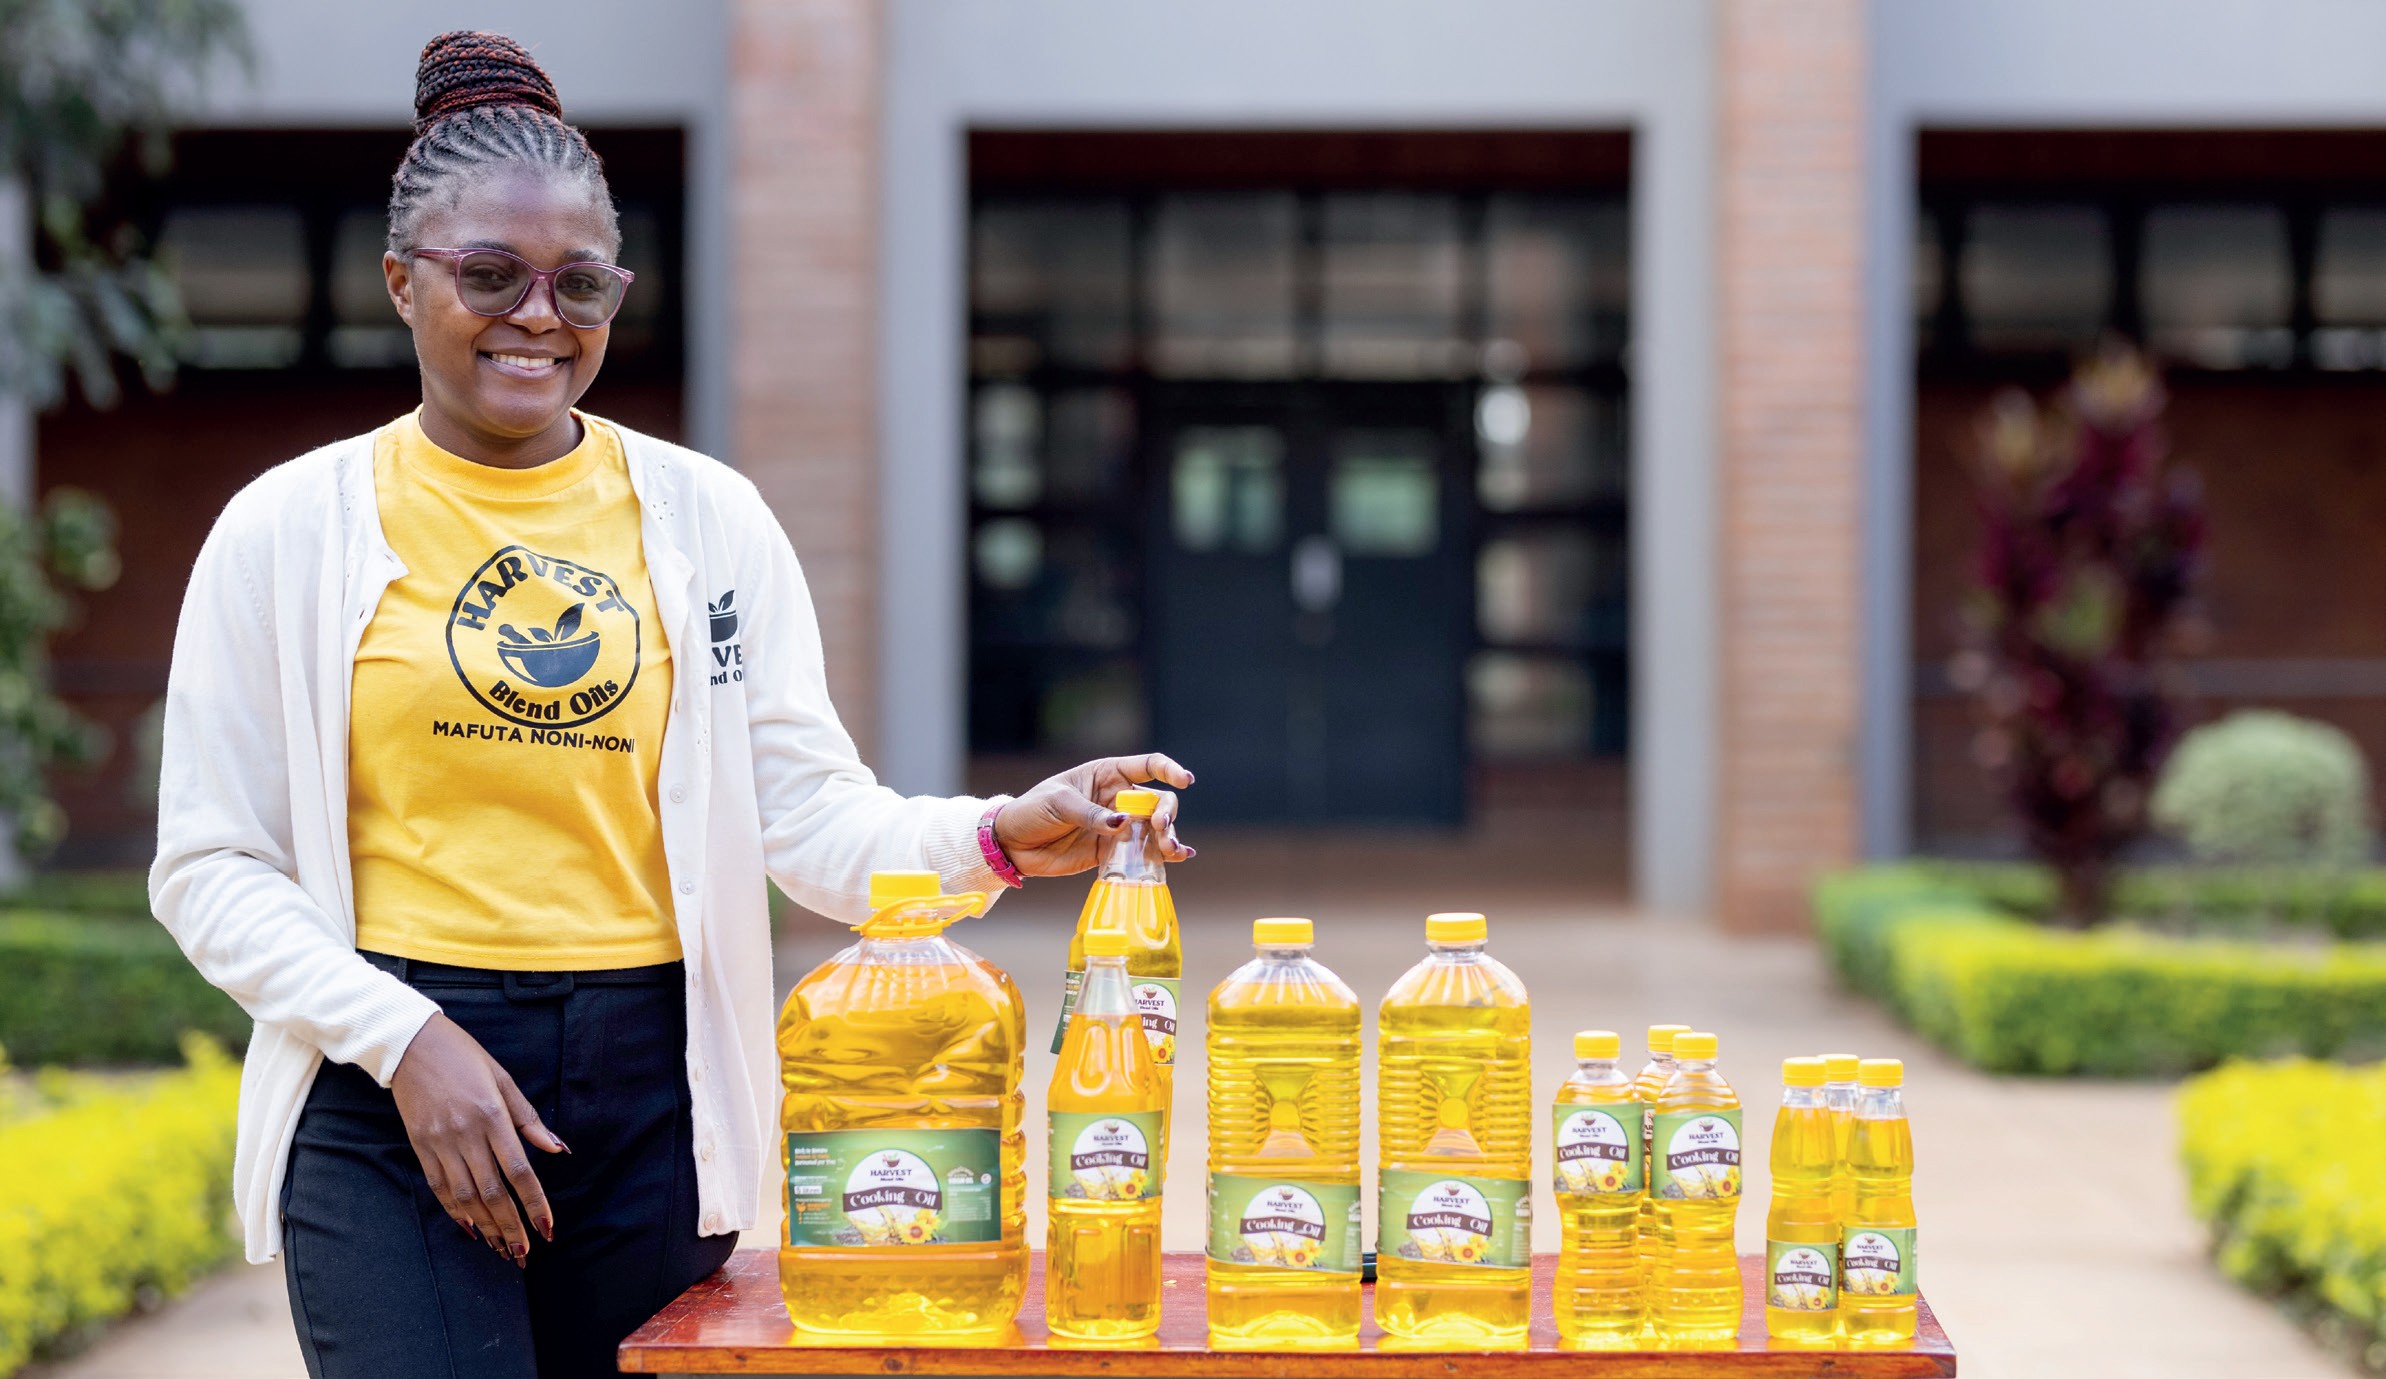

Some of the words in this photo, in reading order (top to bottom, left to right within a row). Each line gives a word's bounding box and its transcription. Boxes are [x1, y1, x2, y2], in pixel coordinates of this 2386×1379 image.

[456, 553, 625, 631] HARVEST
[488, 680, 560, 720] Blend
[570, 679, 618, 715] Oils
[433, 720, 523, 743] MAFUTA
[1075, 1152, 1124, 1168] Cooking
[1130, 1154, 1146, 1167] Oil
[1559, 1144, 1601, 1160] Cooking
[1609, 1146, 1626, 1160] Oil
[1671, 1151, 1719, 1167] Cooking
[1725, 1150, 1739, 1164] Oil
[870, 1169, 912, 1177] HARVEST
[850, 1190, 906, 1208] Cooking
[915, 1190, 936, 1207] Oil
[1246, 1218, 1295, 1232] Cooking
[1302, 1222, 1321, 1238] Oil
[1412, 1214, 1462, 1228] Cooking
[1470, 1218, 1489, 1233] Oil
